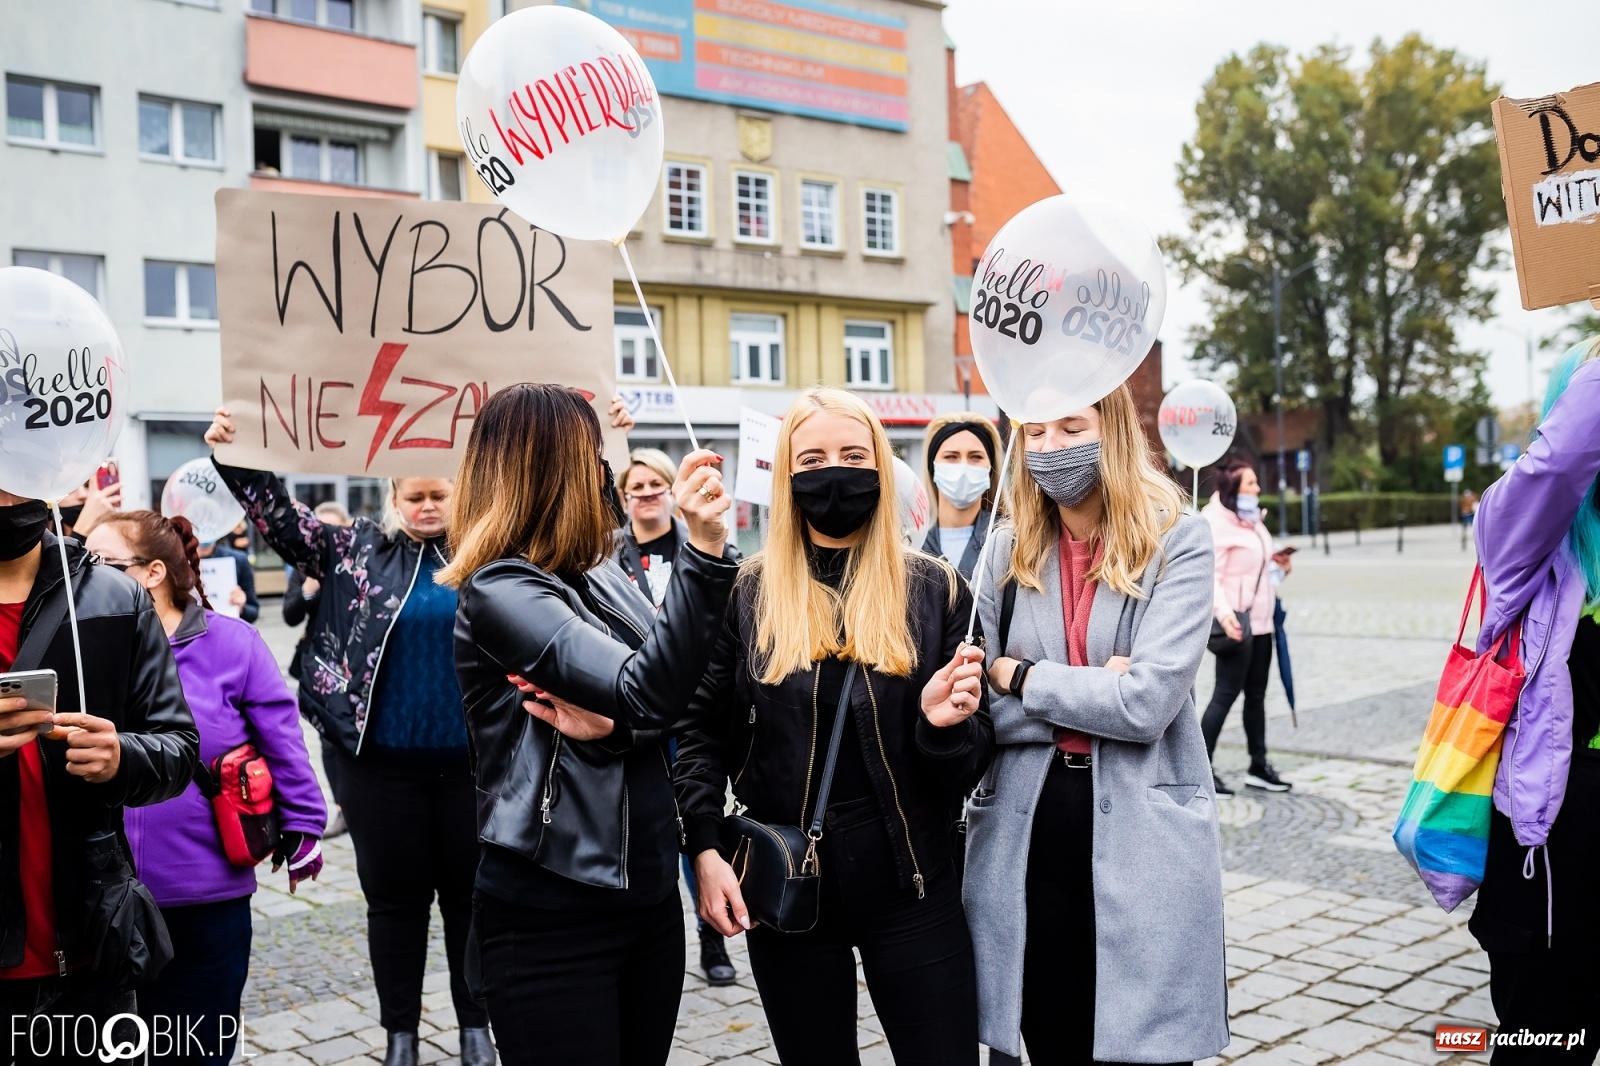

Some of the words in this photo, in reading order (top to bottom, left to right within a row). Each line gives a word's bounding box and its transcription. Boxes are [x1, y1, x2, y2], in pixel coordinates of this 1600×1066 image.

[719, 48, 825, 79] TECHNIKUM
[271, 207, 592, 338] WYBÓR
[982, 248, 1049, 309] hello
[973, 288, 1043, 346] 2020
[23, 346, 108, 396] hello
[23, 388, 112, 430] 2020
[261, 374, 354, 452] NIE
[180, 472, 217, 494] 2020
